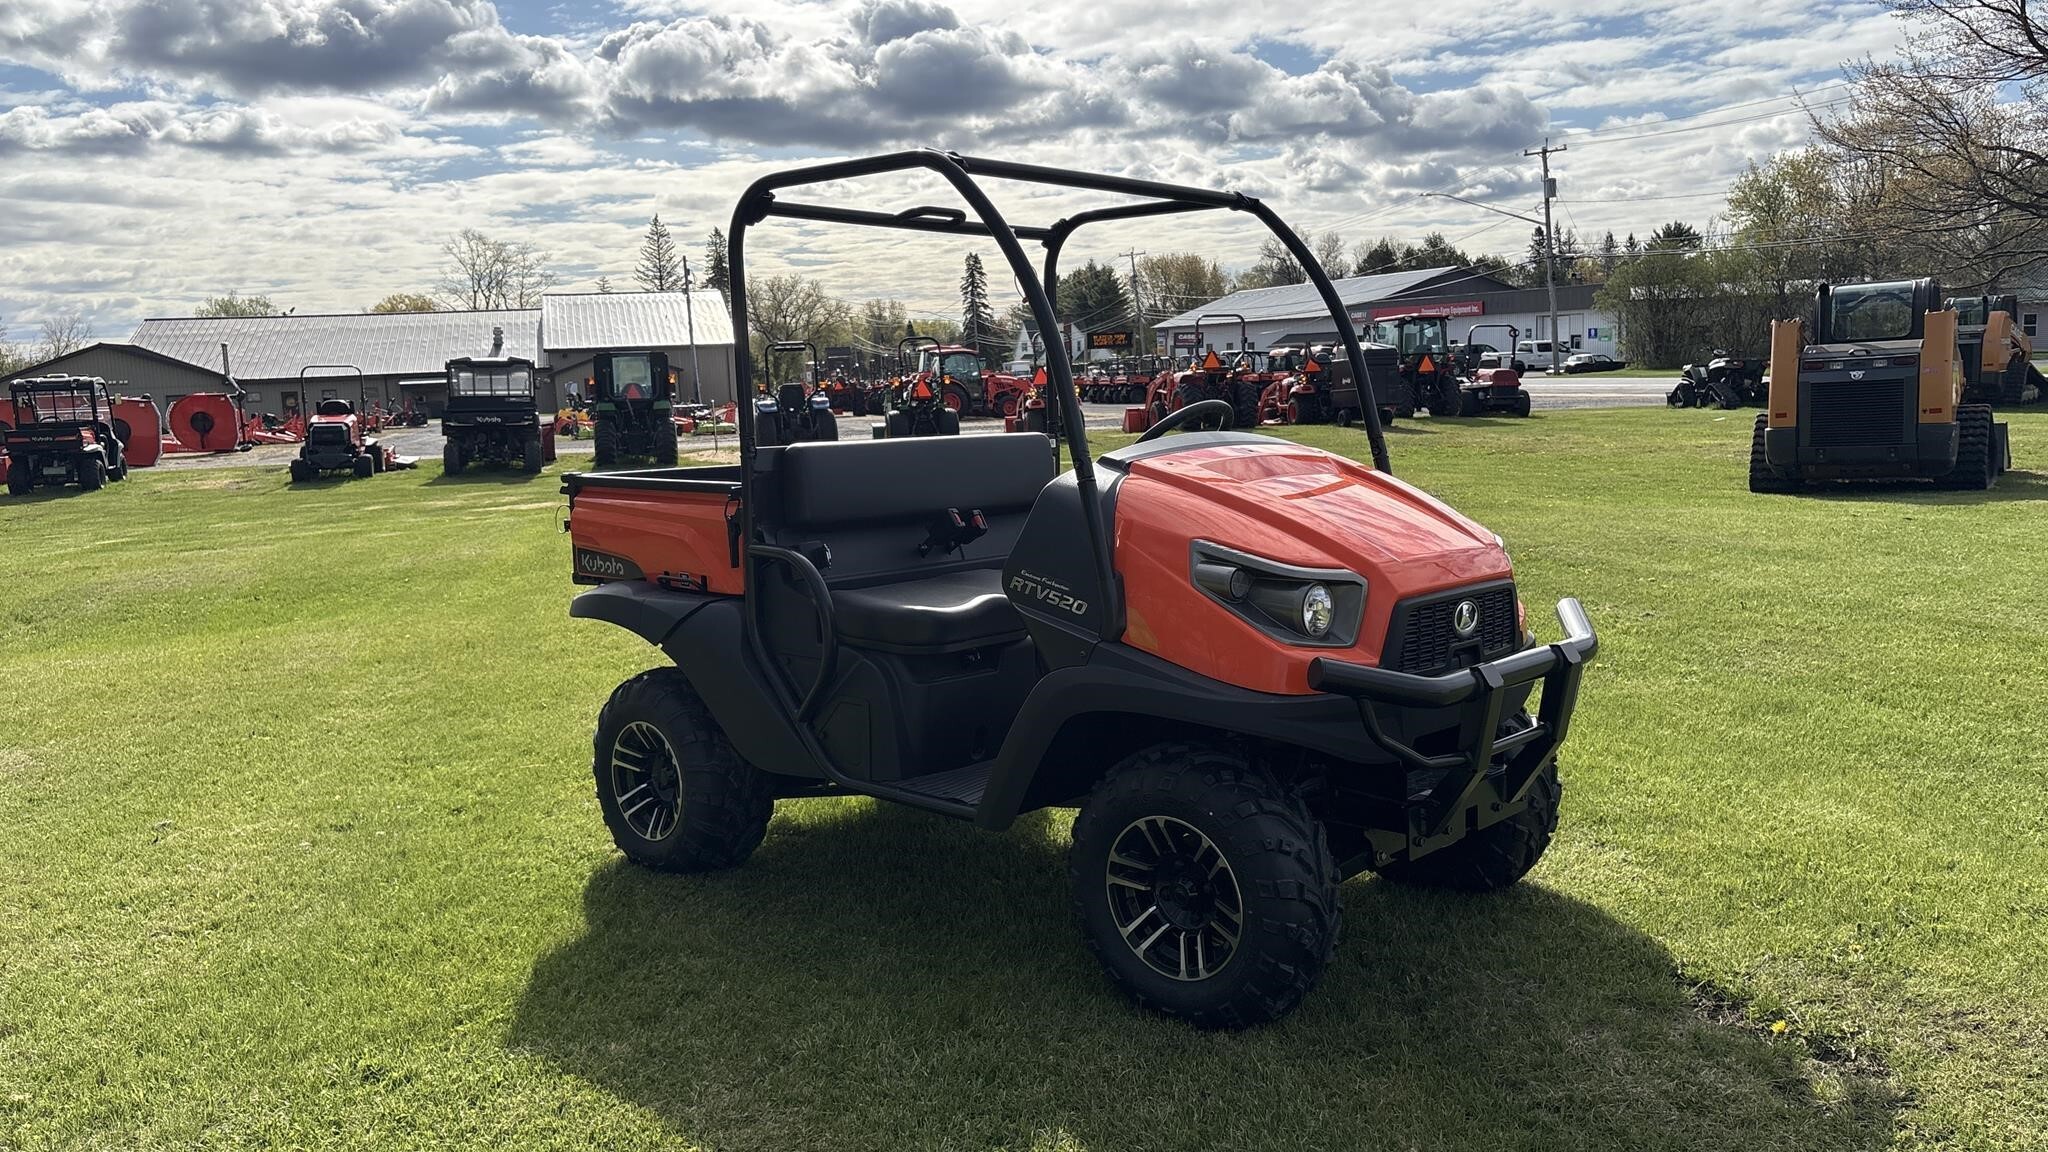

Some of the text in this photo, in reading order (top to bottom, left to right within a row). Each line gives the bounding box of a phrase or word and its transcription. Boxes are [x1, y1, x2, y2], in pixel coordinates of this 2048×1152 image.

[1451, 305, 1471, 317] Equipment
[1472, 304, 1480, 312] Inc.
[581, 554, 625, 576] Kubota
[1009, 576, 1088, 615] RTV520
